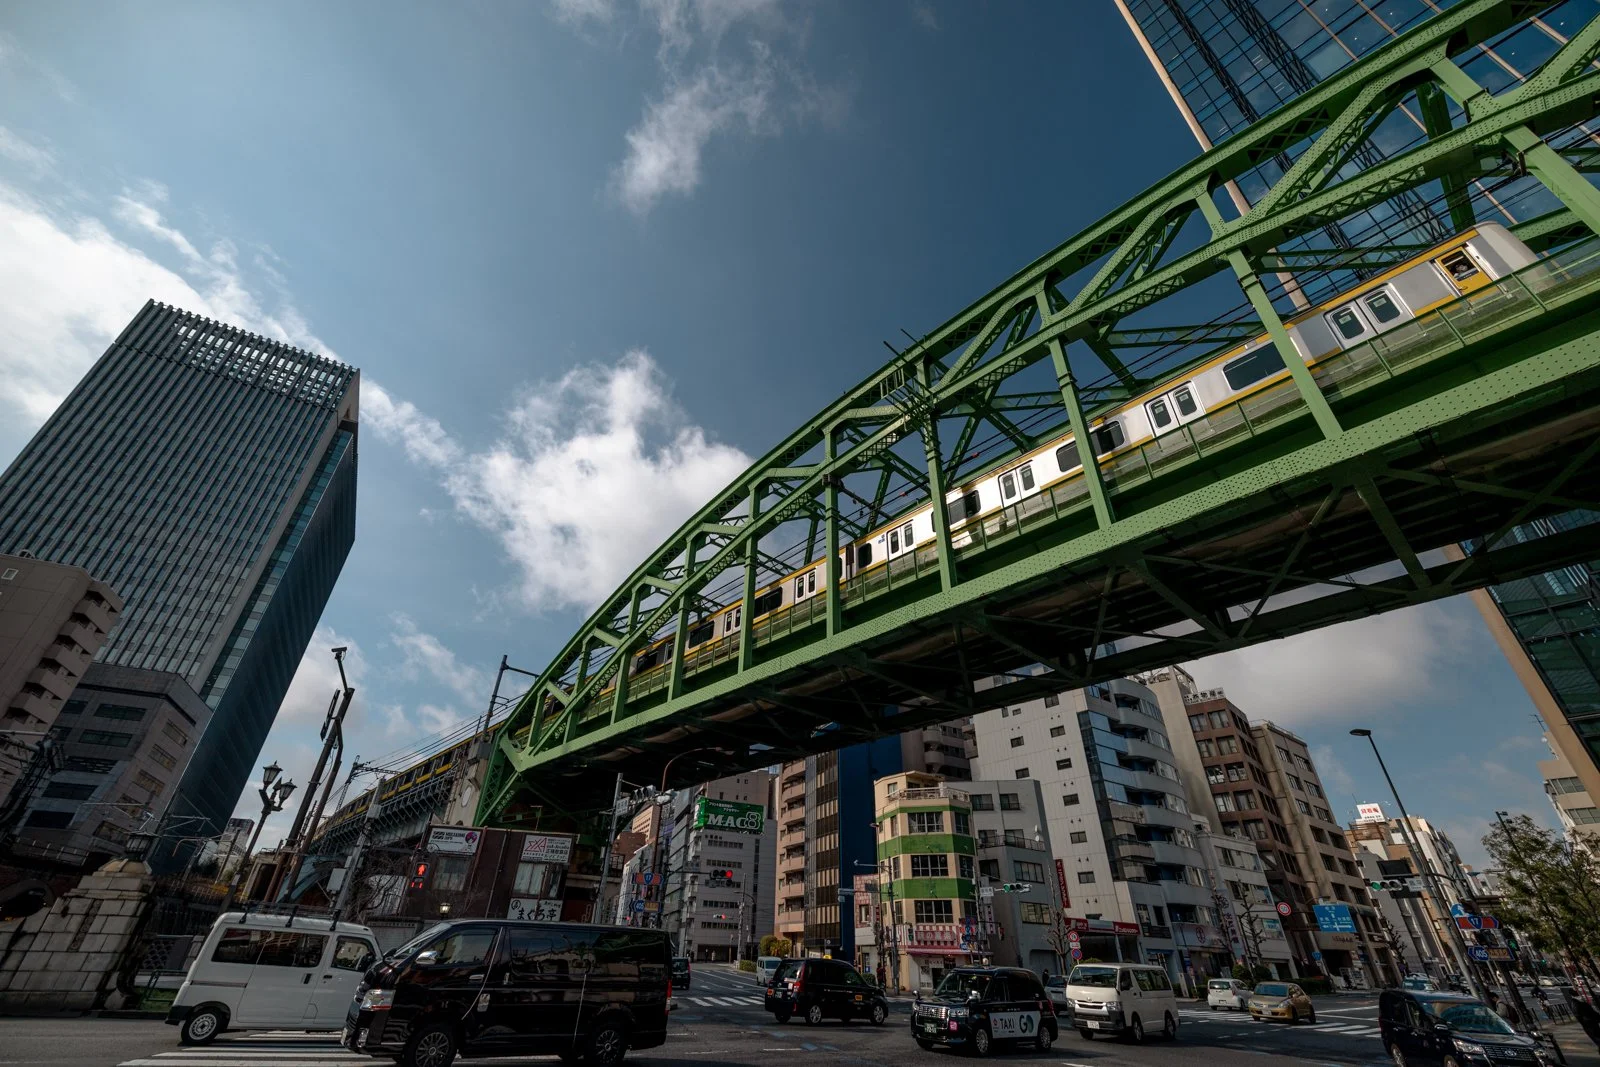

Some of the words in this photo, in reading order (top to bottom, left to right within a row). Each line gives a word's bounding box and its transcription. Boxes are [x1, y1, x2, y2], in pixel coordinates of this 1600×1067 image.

[1470, 917, 1479, 925] 17
[1475, 949, 1488, 957] 405
[999, 1017, 1015, 1030] TAXI
[1019, 1014, 1034, 1034] GO
